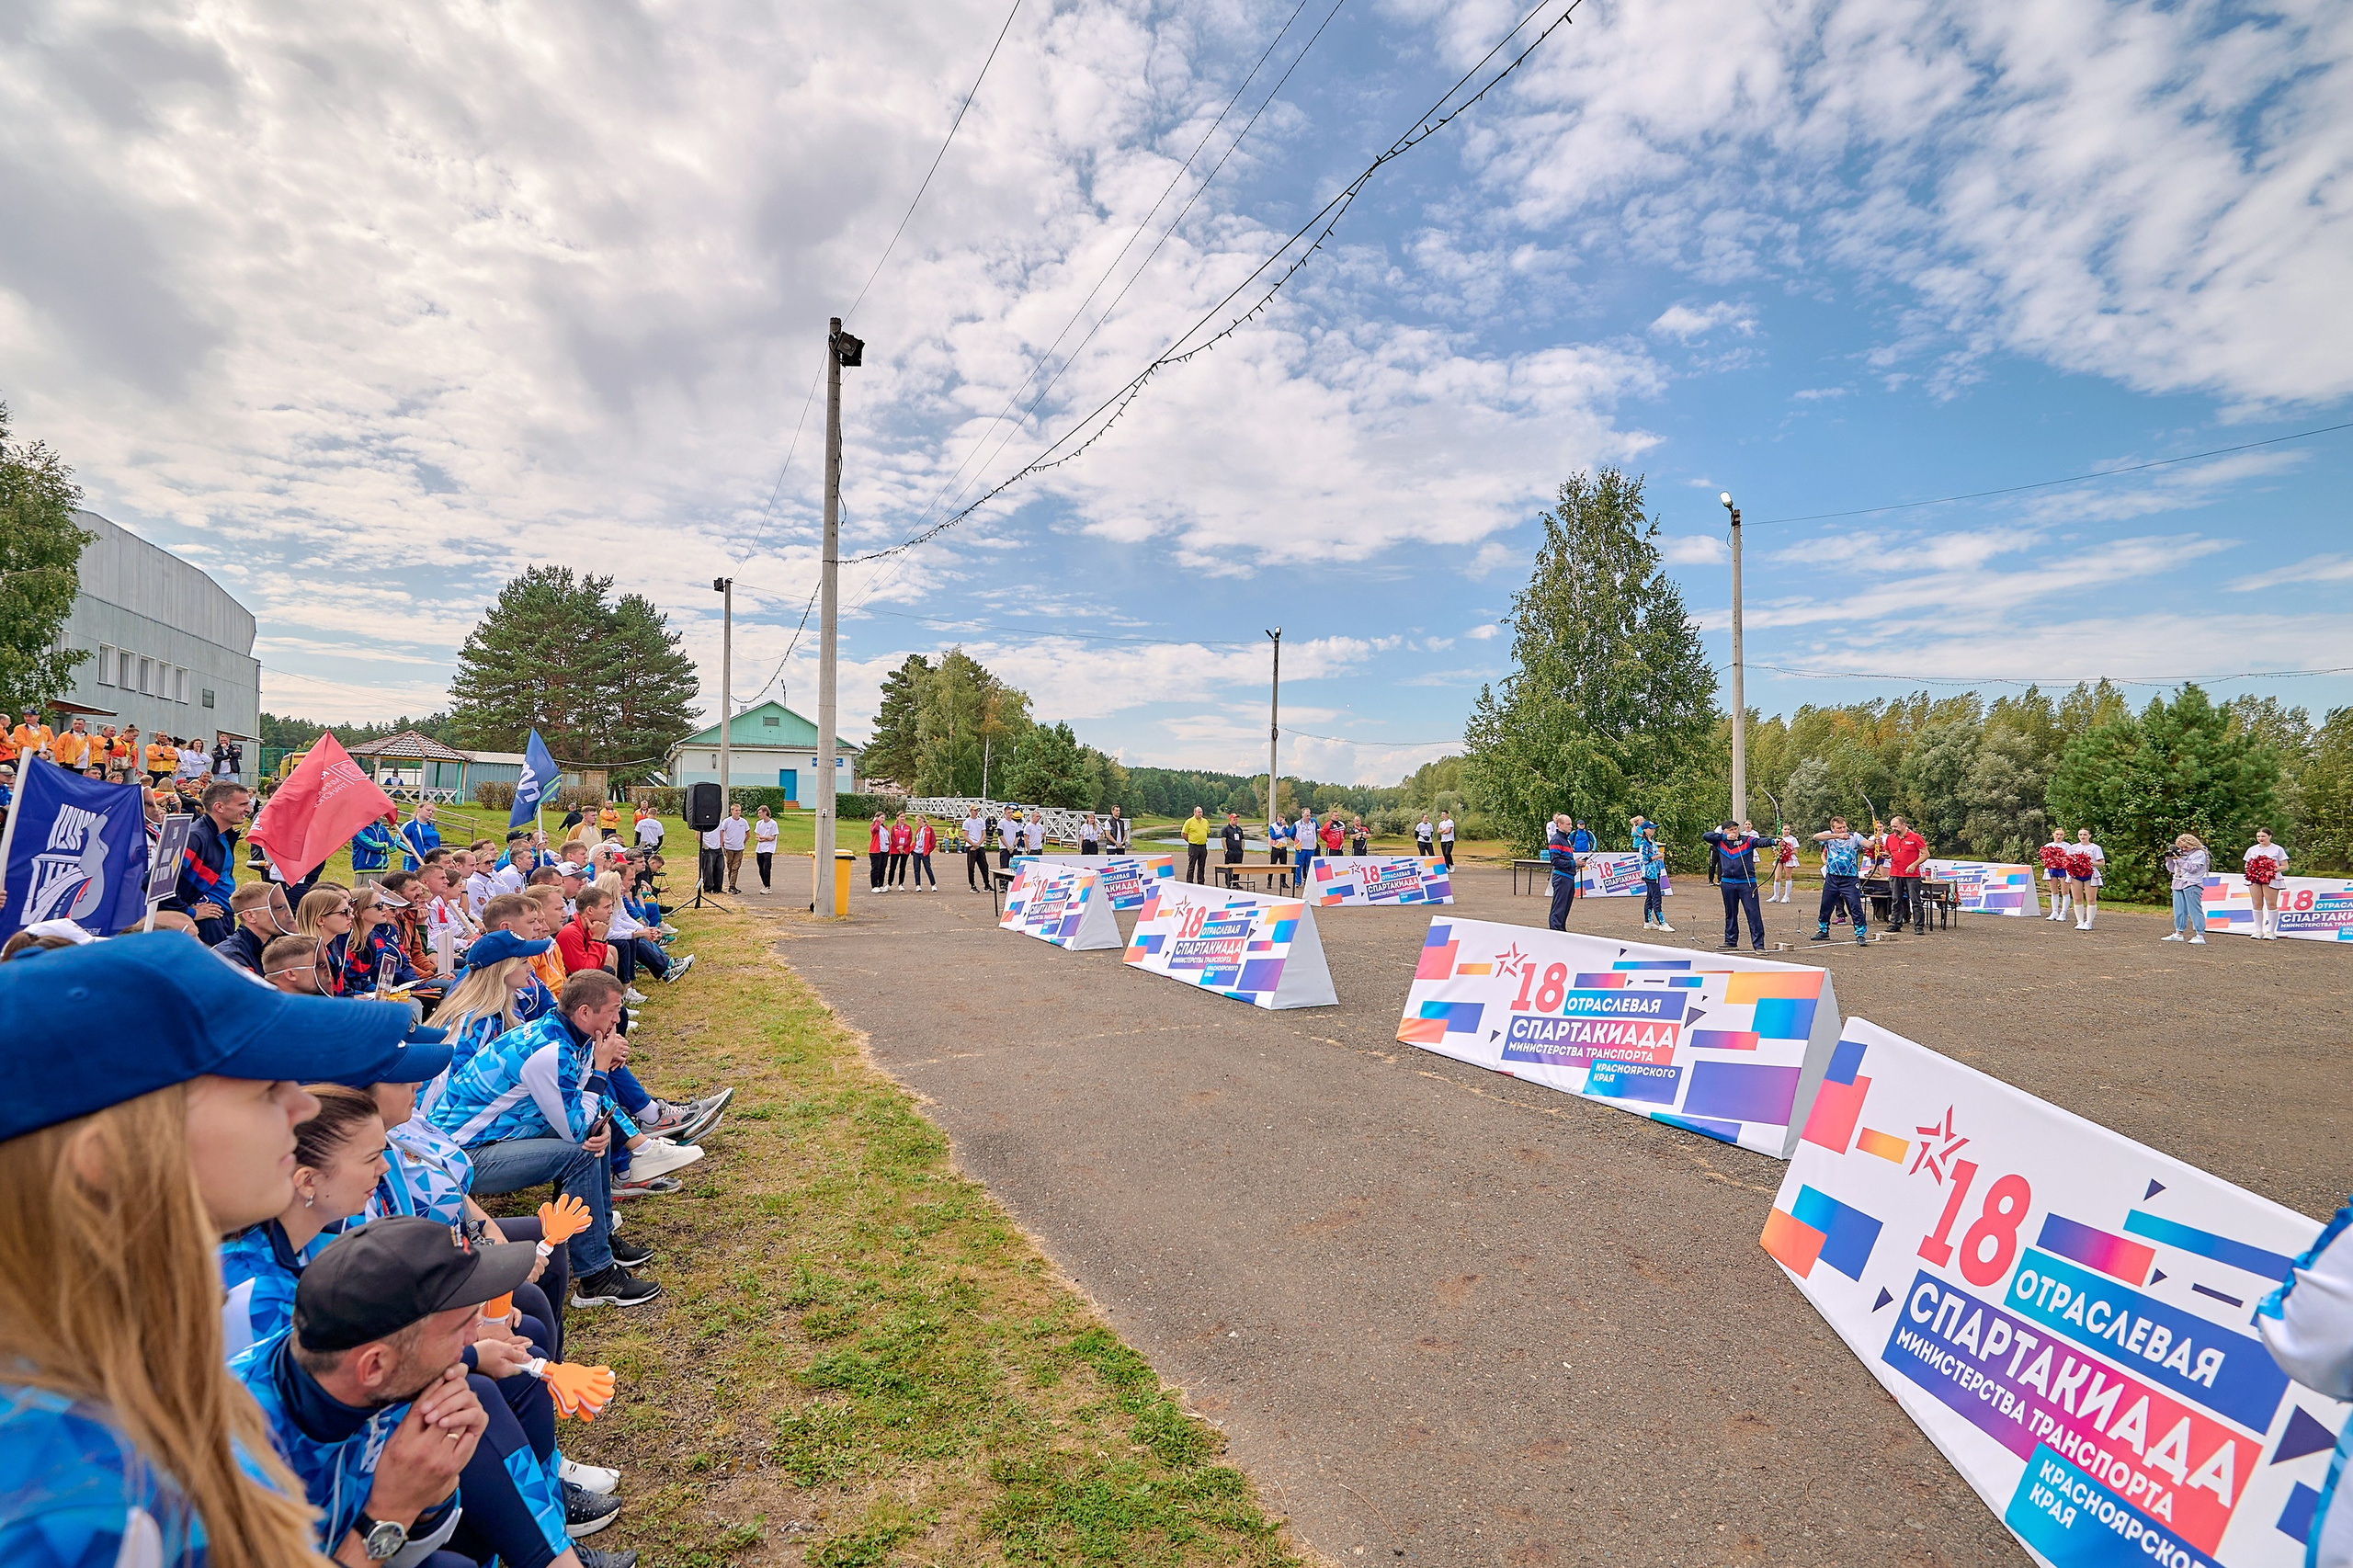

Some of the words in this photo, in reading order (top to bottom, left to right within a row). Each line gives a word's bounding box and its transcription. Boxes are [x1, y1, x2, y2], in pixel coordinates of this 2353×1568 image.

[1361, 865, 1381, 884] 18
[1381, 869, 1411, 880] ОТРАСЛЕВАЯ
[1597, 861, 1613, 879] 18
[1031, 878, 1049, 903] 18
[1368, 878, 1419, 893] СПАРТАКИАДА
[2278, 890, 2313, 911] 18
[1176, 906, 1207, 938] 18
[1201, 924, 1242, 936] ОТРАСЛЕВАЯ
[1176, 939, 1243, 955] СПАРТАКИАДА
[1510, 962, 1568, 1013] 18
[1566, 997, 1662, 1013] ОТРАСЛЕВАЯ
[1512, 1018, 1675, 1049] СПАРТАКИАДА
[1507, 1041, 1584, 1057] МИНИСТЕРСТВА
[1586, 1047, 1654, 1062] ТРАНСПОРТА
[1593, 1074, 1616, 1083] КРАЯ
[1596, 1062, 1676, 1079] КРАСНОЯРСКОГО
[1916, 1158, 2031, 1287] 18
[2016, 1269, 2225, 1389] ОТРАСЛЕВАЯ
[1910, 1282, 2235, 1509] СПАРТАКИАДА
[1896, 1326, 2026, 1425] МИНИСТЕРСТВА
[2028, 1408, 2173, 1523] ТРАНСПОРТА
[2029, 1482, 2078, 1529] КРАЯ
